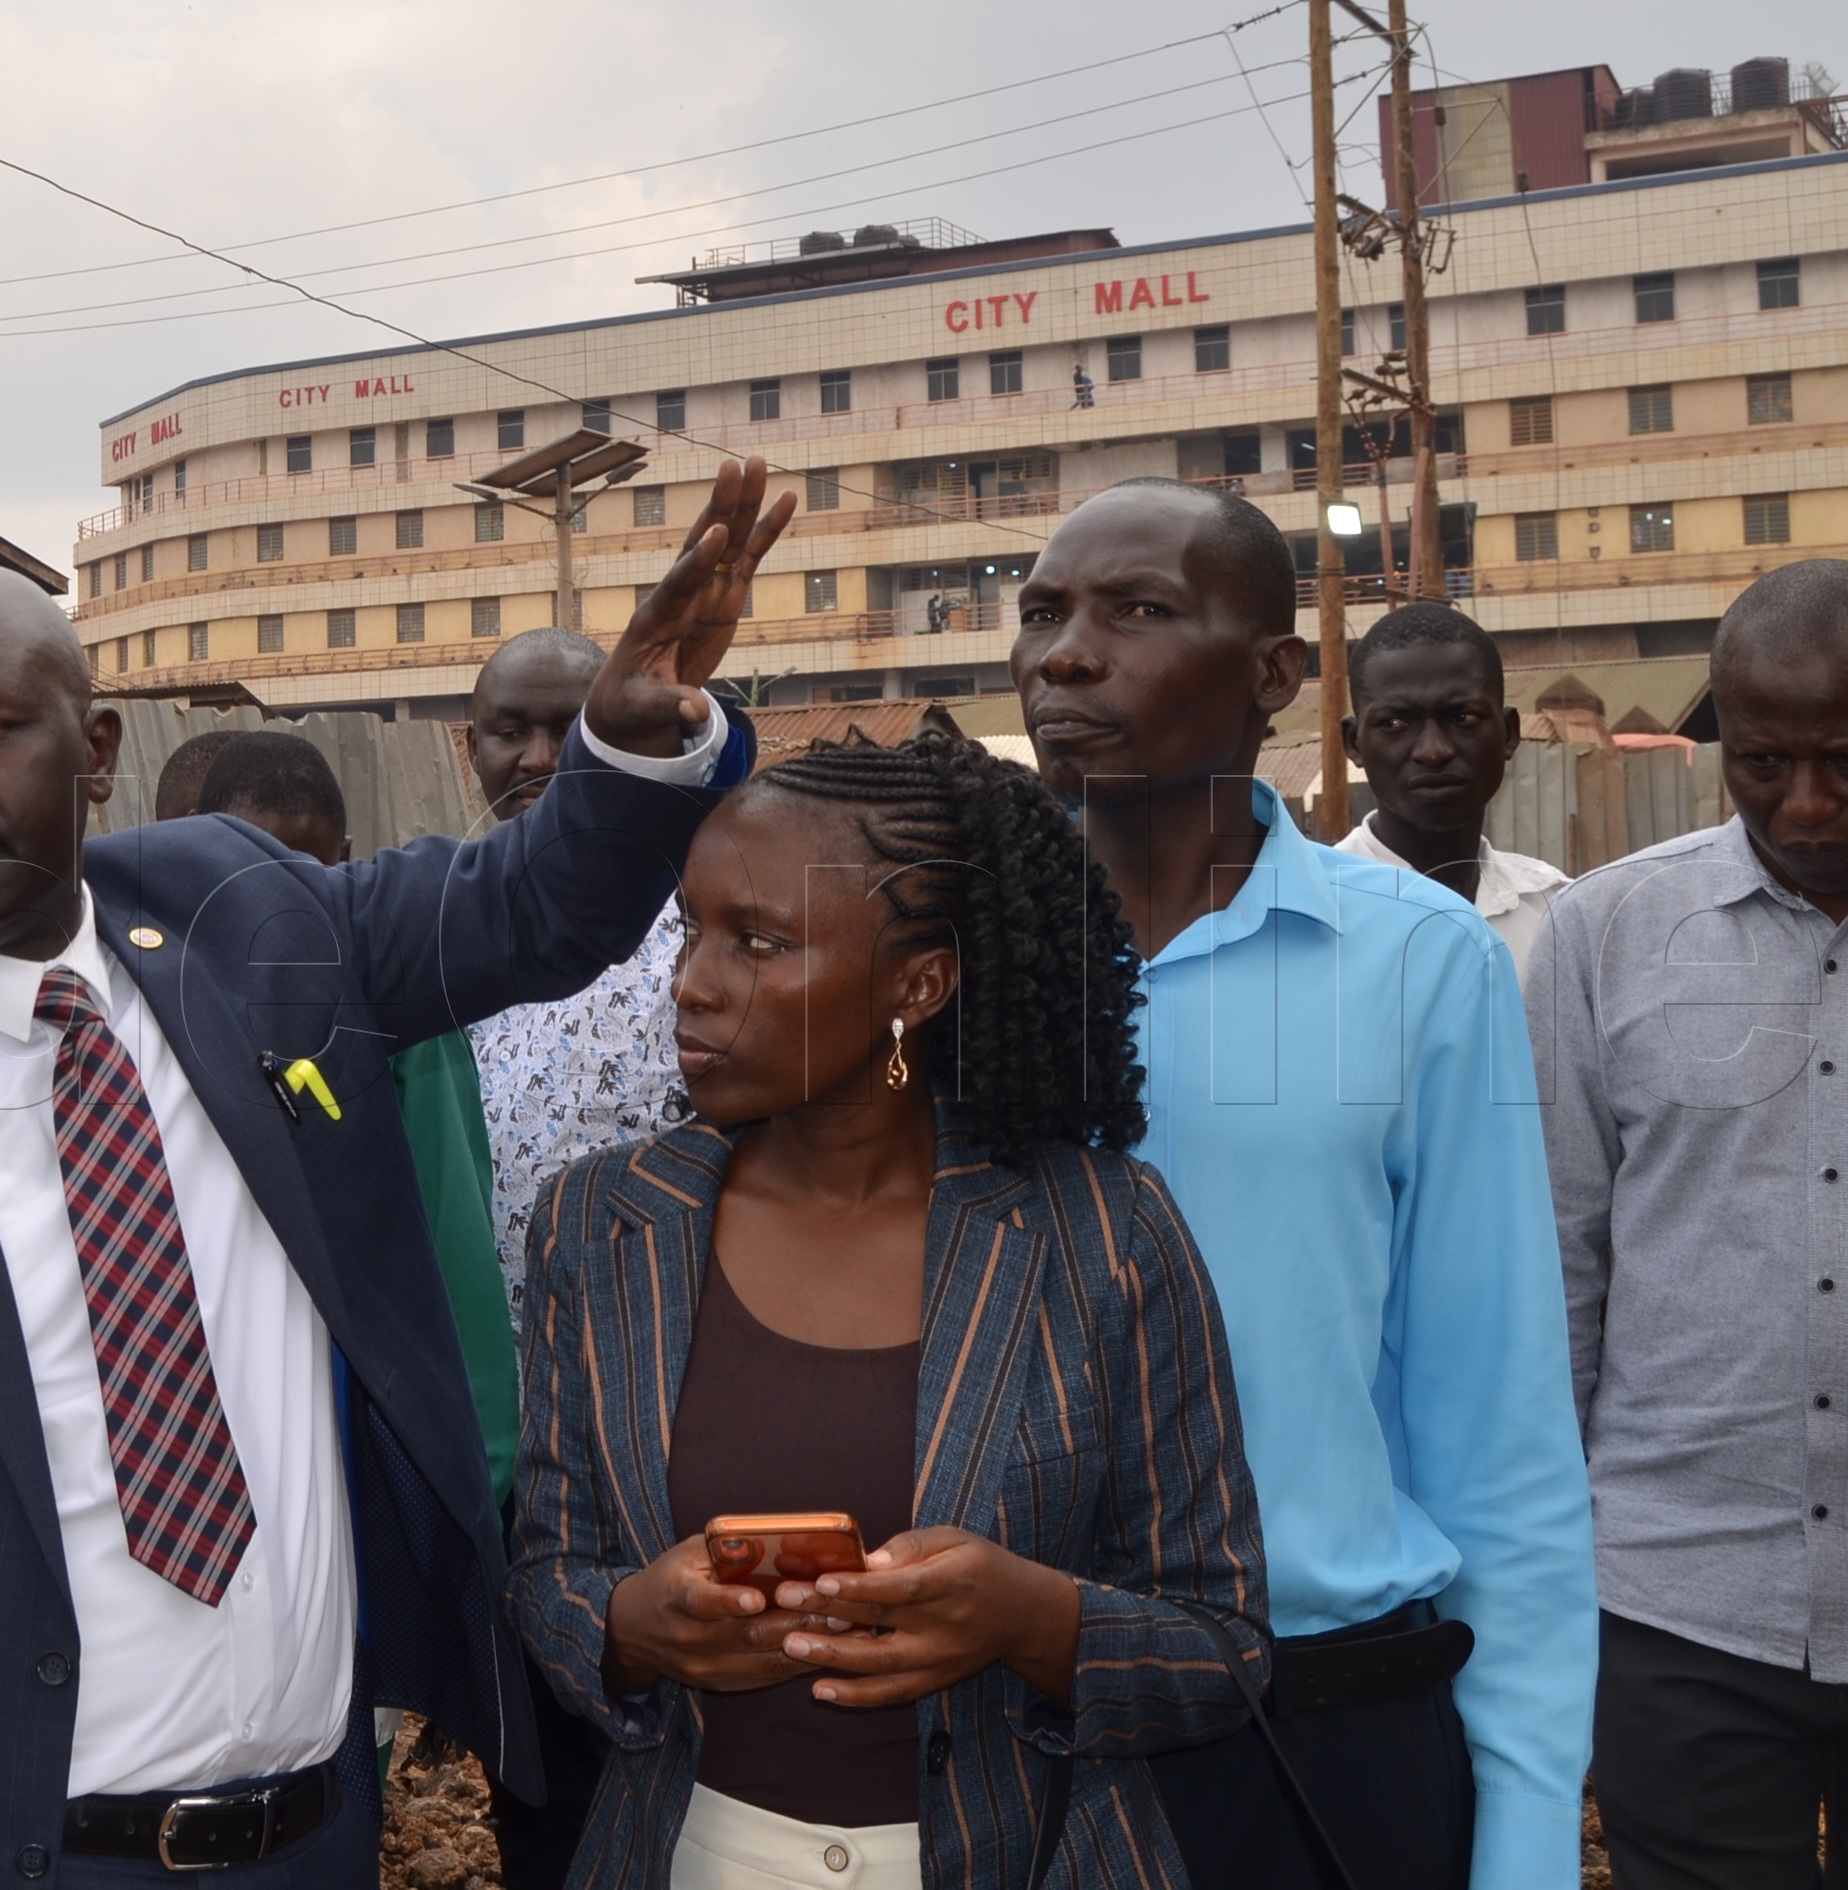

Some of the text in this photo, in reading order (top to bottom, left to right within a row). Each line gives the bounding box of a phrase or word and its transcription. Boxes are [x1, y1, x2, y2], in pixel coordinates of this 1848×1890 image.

[945, 271, 1210, 333] CITY MALL
[279, 374, 414, 408] CITY MALL
[112, 412, 182, 462] CITY MALL
